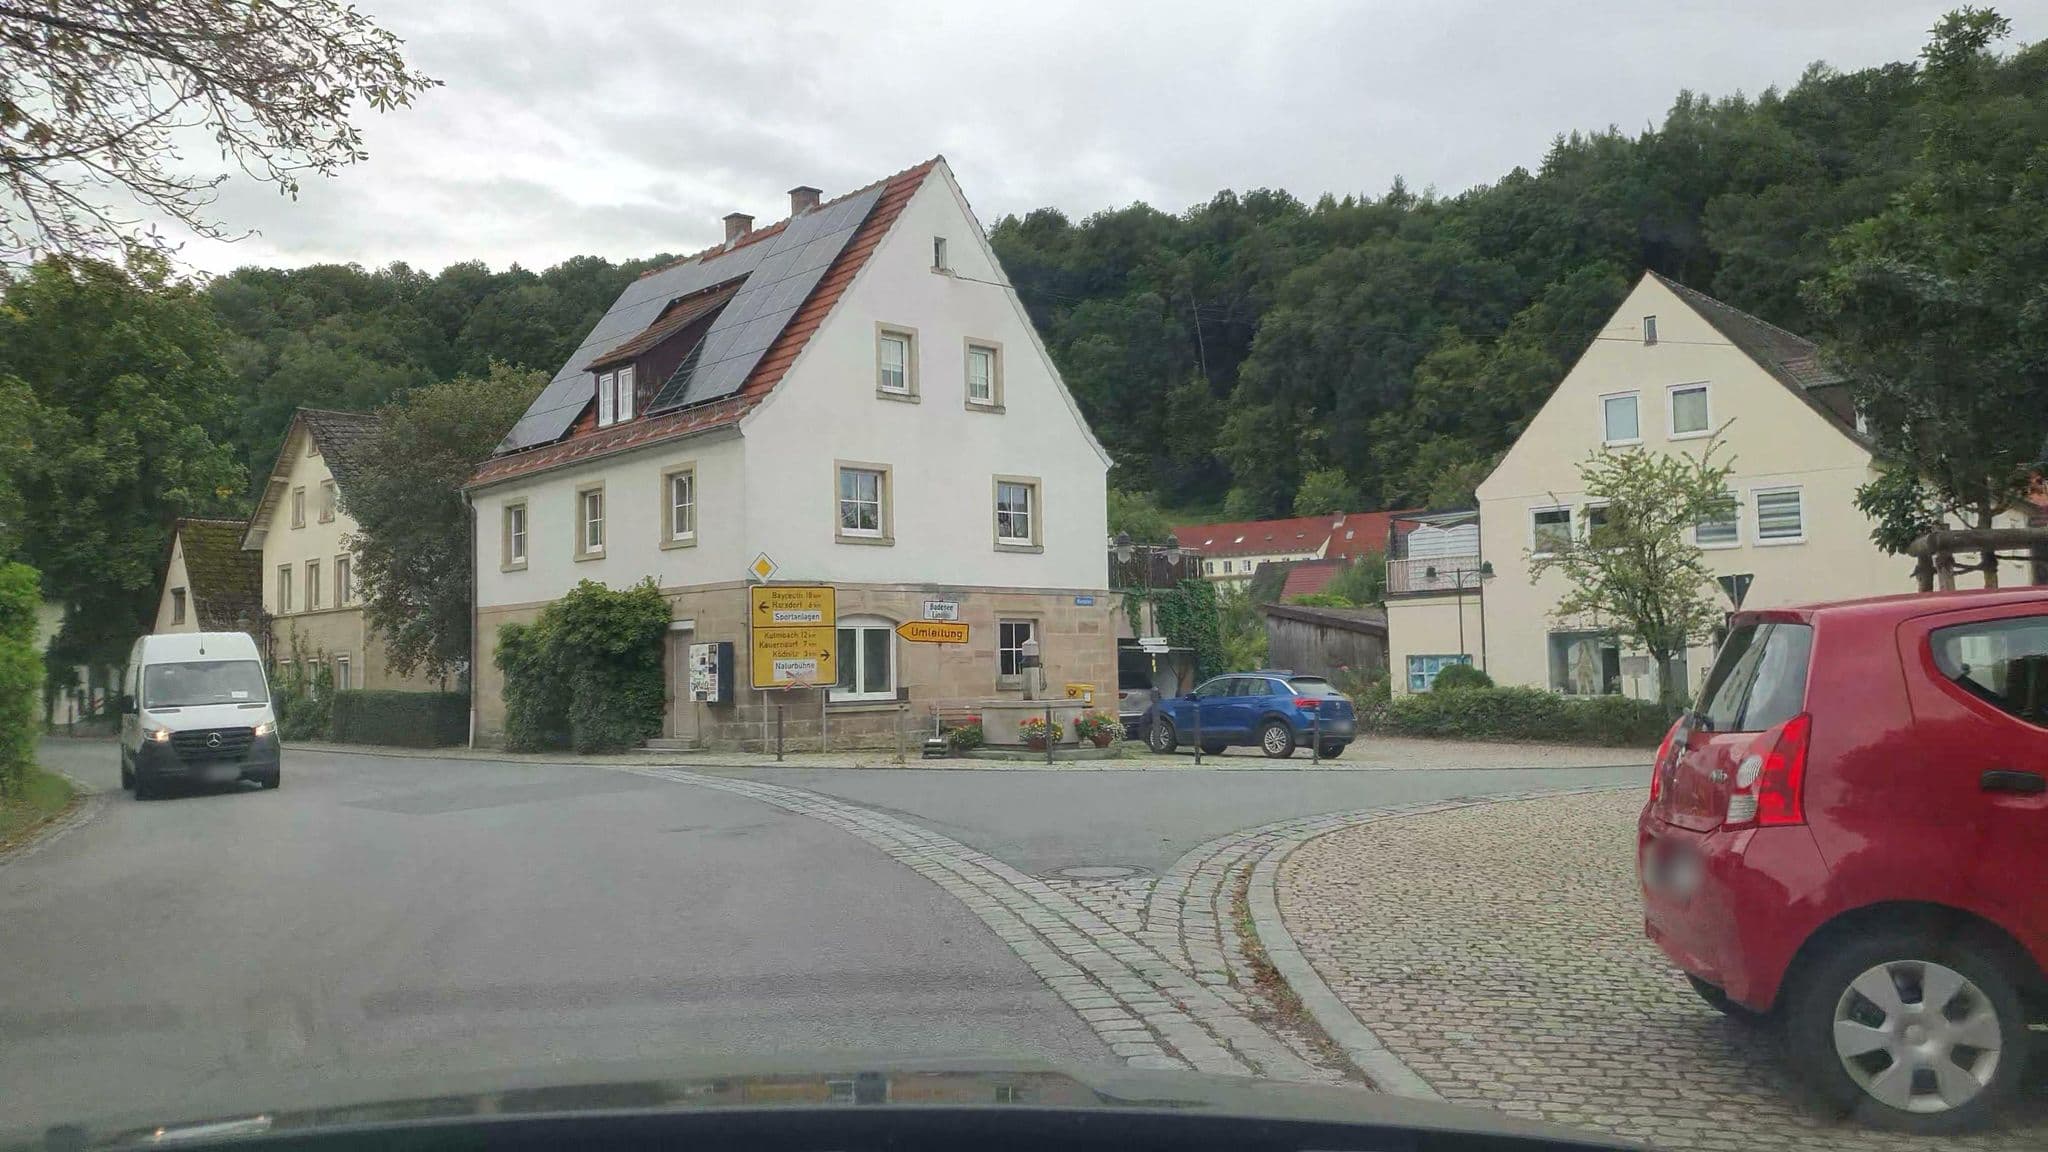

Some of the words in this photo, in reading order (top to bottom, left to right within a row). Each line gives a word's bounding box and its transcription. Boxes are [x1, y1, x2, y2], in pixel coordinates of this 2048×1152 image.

[771, 591, 803, 600] Bayreuth
[929, 603, 953, 611] Badesee
[775, 613, 820, 621] Sportanlagen
[764, 631, 799, 639] Kulmbach
[801, 631, 808, 639] 12
[911, 627, 963, 640] Umleitung
